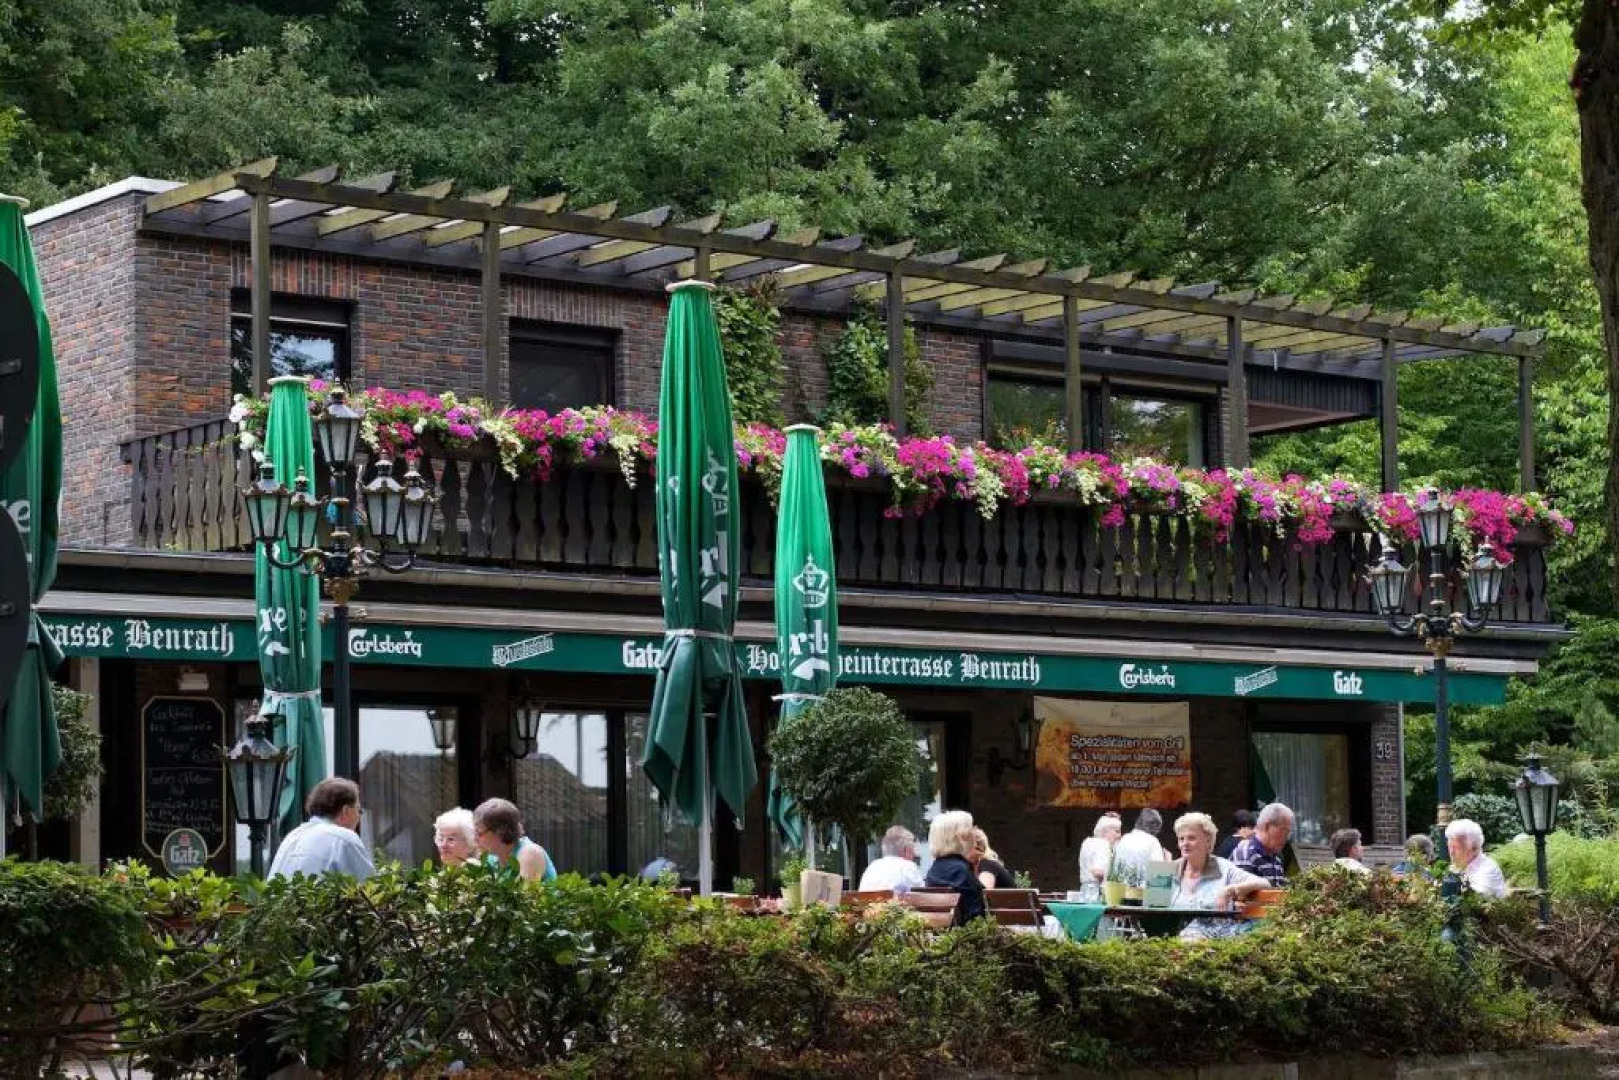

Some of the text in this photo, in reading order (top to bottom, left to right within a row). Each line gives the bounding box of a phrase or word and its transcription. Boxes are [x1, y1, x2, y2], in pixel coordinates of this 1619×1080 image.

[125, 619, 235, 657] Benrath
[348, 628, 423, 658] Carlsberg
[622, 640, 662, 668] Gatz
[960, 652, 1040, 685] Benrath
[1119, 663, 1176, 689] Carlsberg
[1333, 670, 1363, 695] Gatz
[1376, 742, 1392, 759] 39
